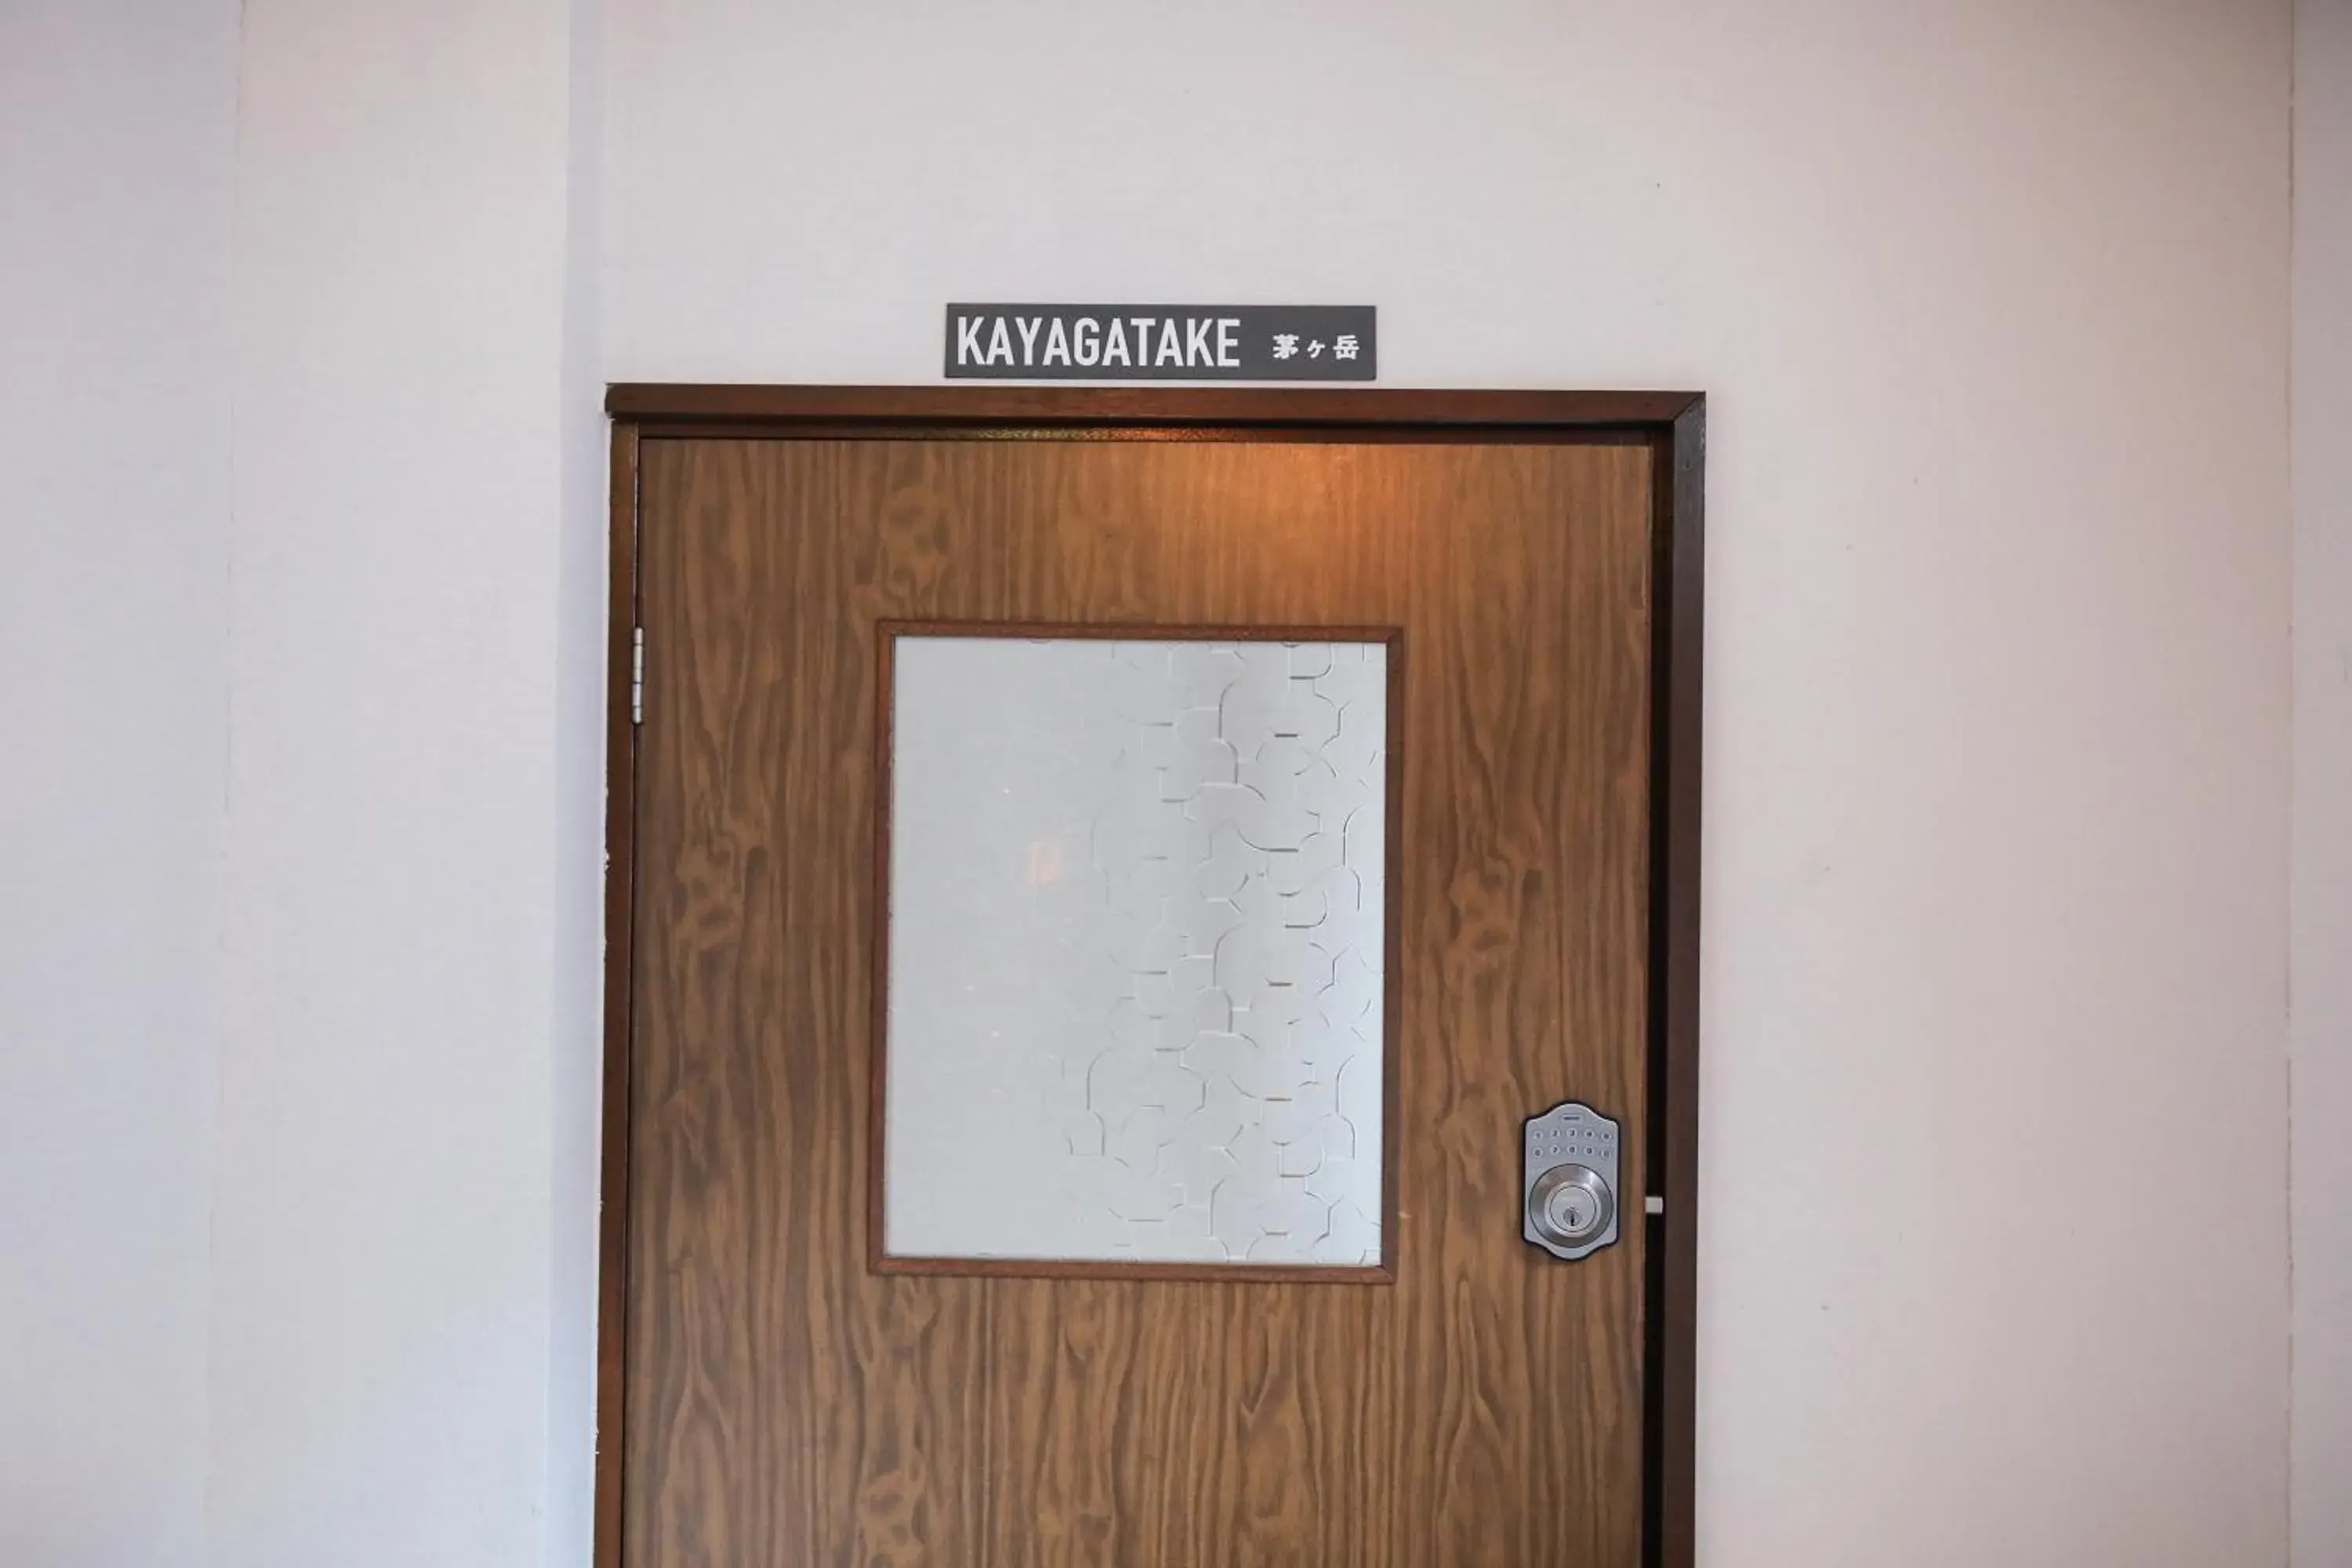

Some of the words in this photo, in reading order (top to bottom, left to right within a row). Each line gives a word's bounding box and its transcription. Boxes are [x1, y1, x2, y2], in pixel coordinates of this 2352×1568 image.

[956, 315, 1241, 367] KAYAGATAKE
[1272, 333, 1360, 360] 茅ヶ岳
